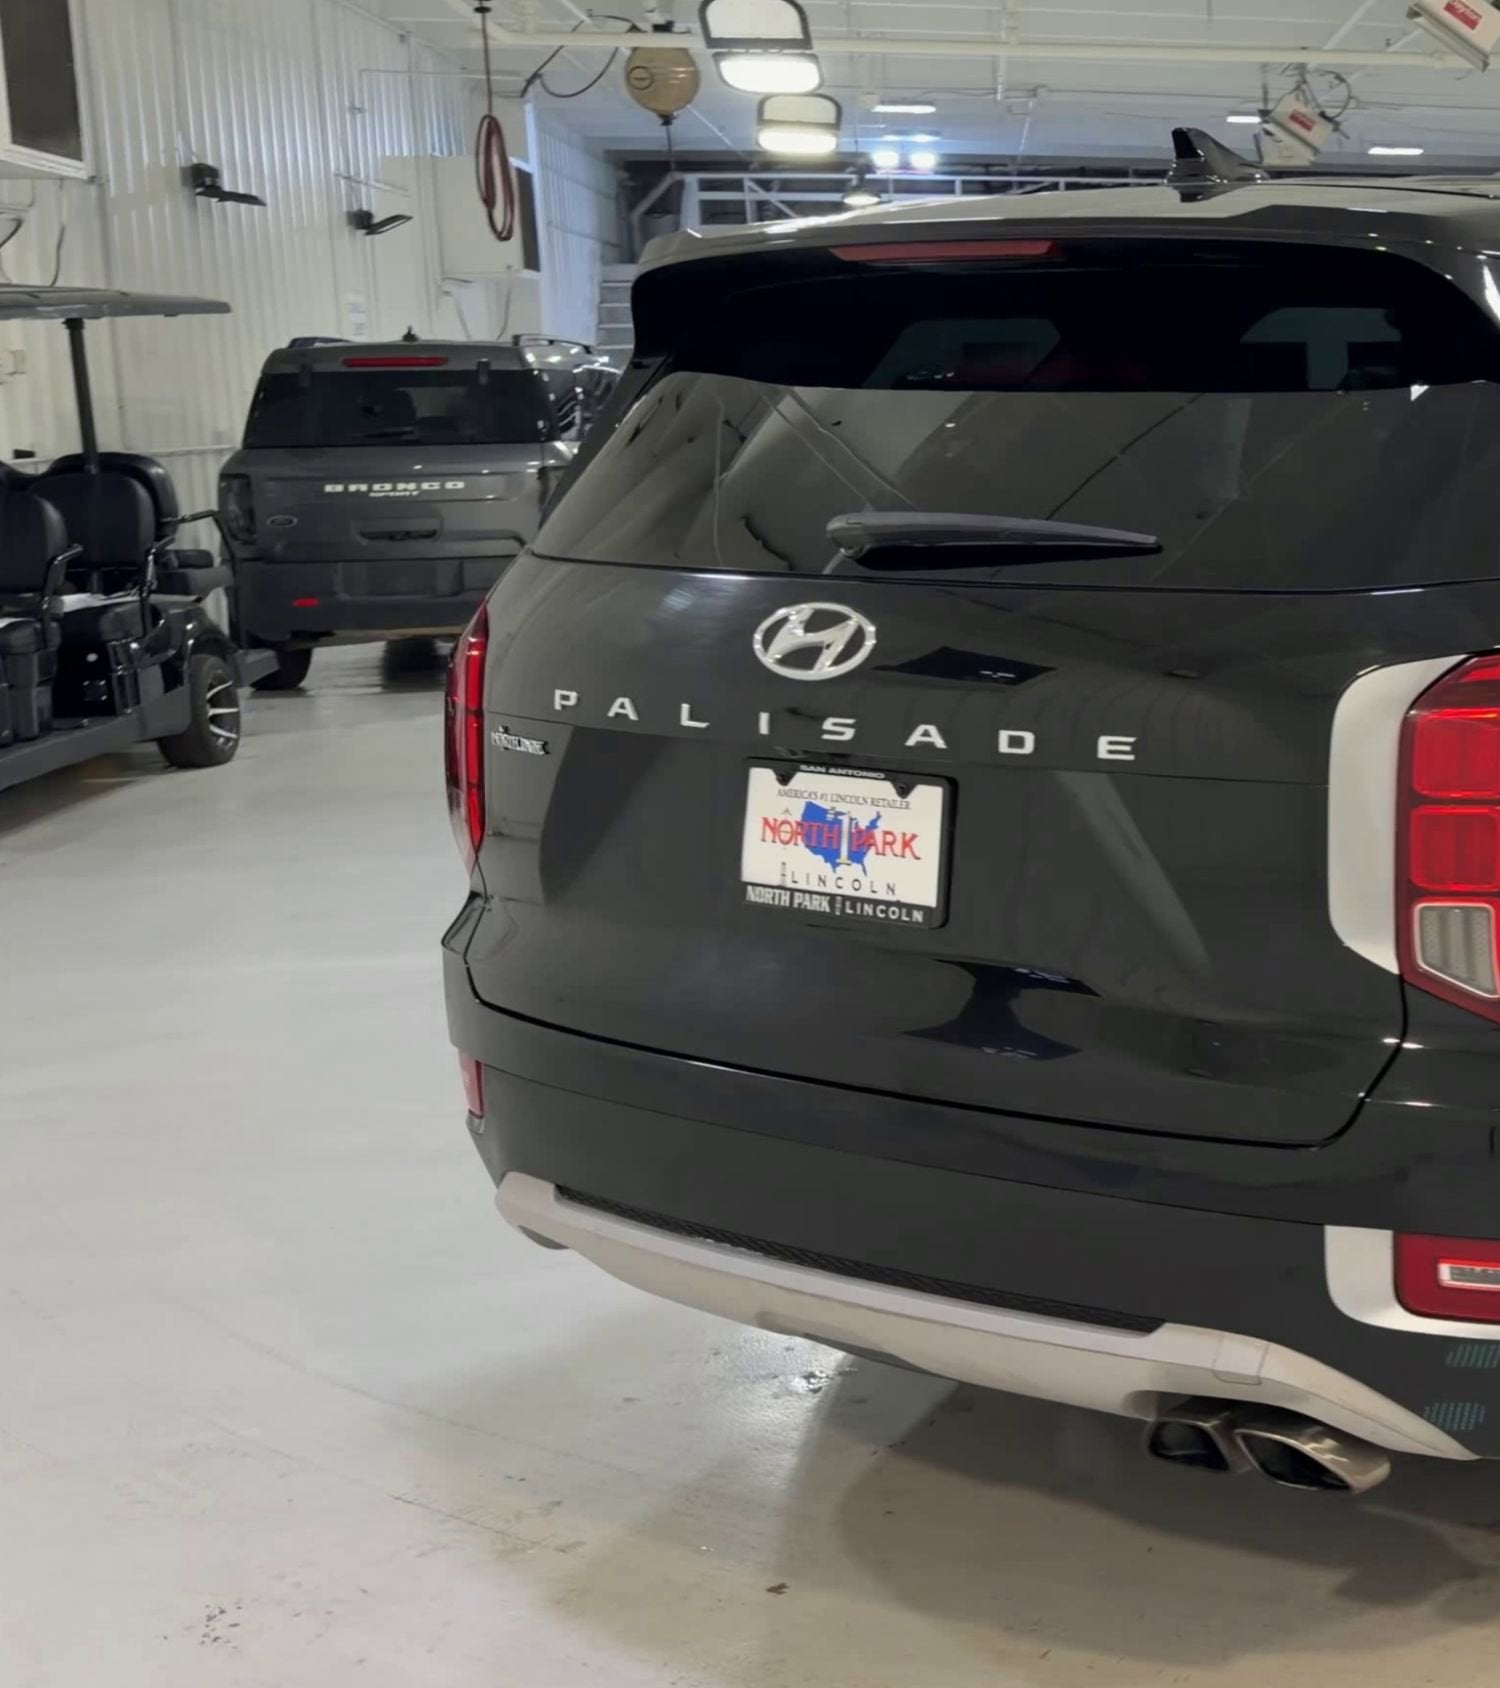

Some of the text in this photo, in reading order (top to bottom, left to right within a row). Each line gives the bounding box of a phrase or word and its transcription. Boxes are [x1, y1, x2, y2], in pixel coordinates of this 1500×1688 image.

[323, 481, 465, 493] BRONCO
[553, 688, 1136, 761] PALISADE
[799, 764, 886, 779] SAN ANTONIO
[829, 792, 869, 806] LINCOLN
[869, 796, 912, 811] RETAILER
[760, 816, 922, 860] NORTH PARK
[791, 870, 896, 896] LINCOLN
[745, 884, 790, 908] NORTH
[792, 890, 831, 913] PARK
[845, 900, 924, 923] LINCOLN
